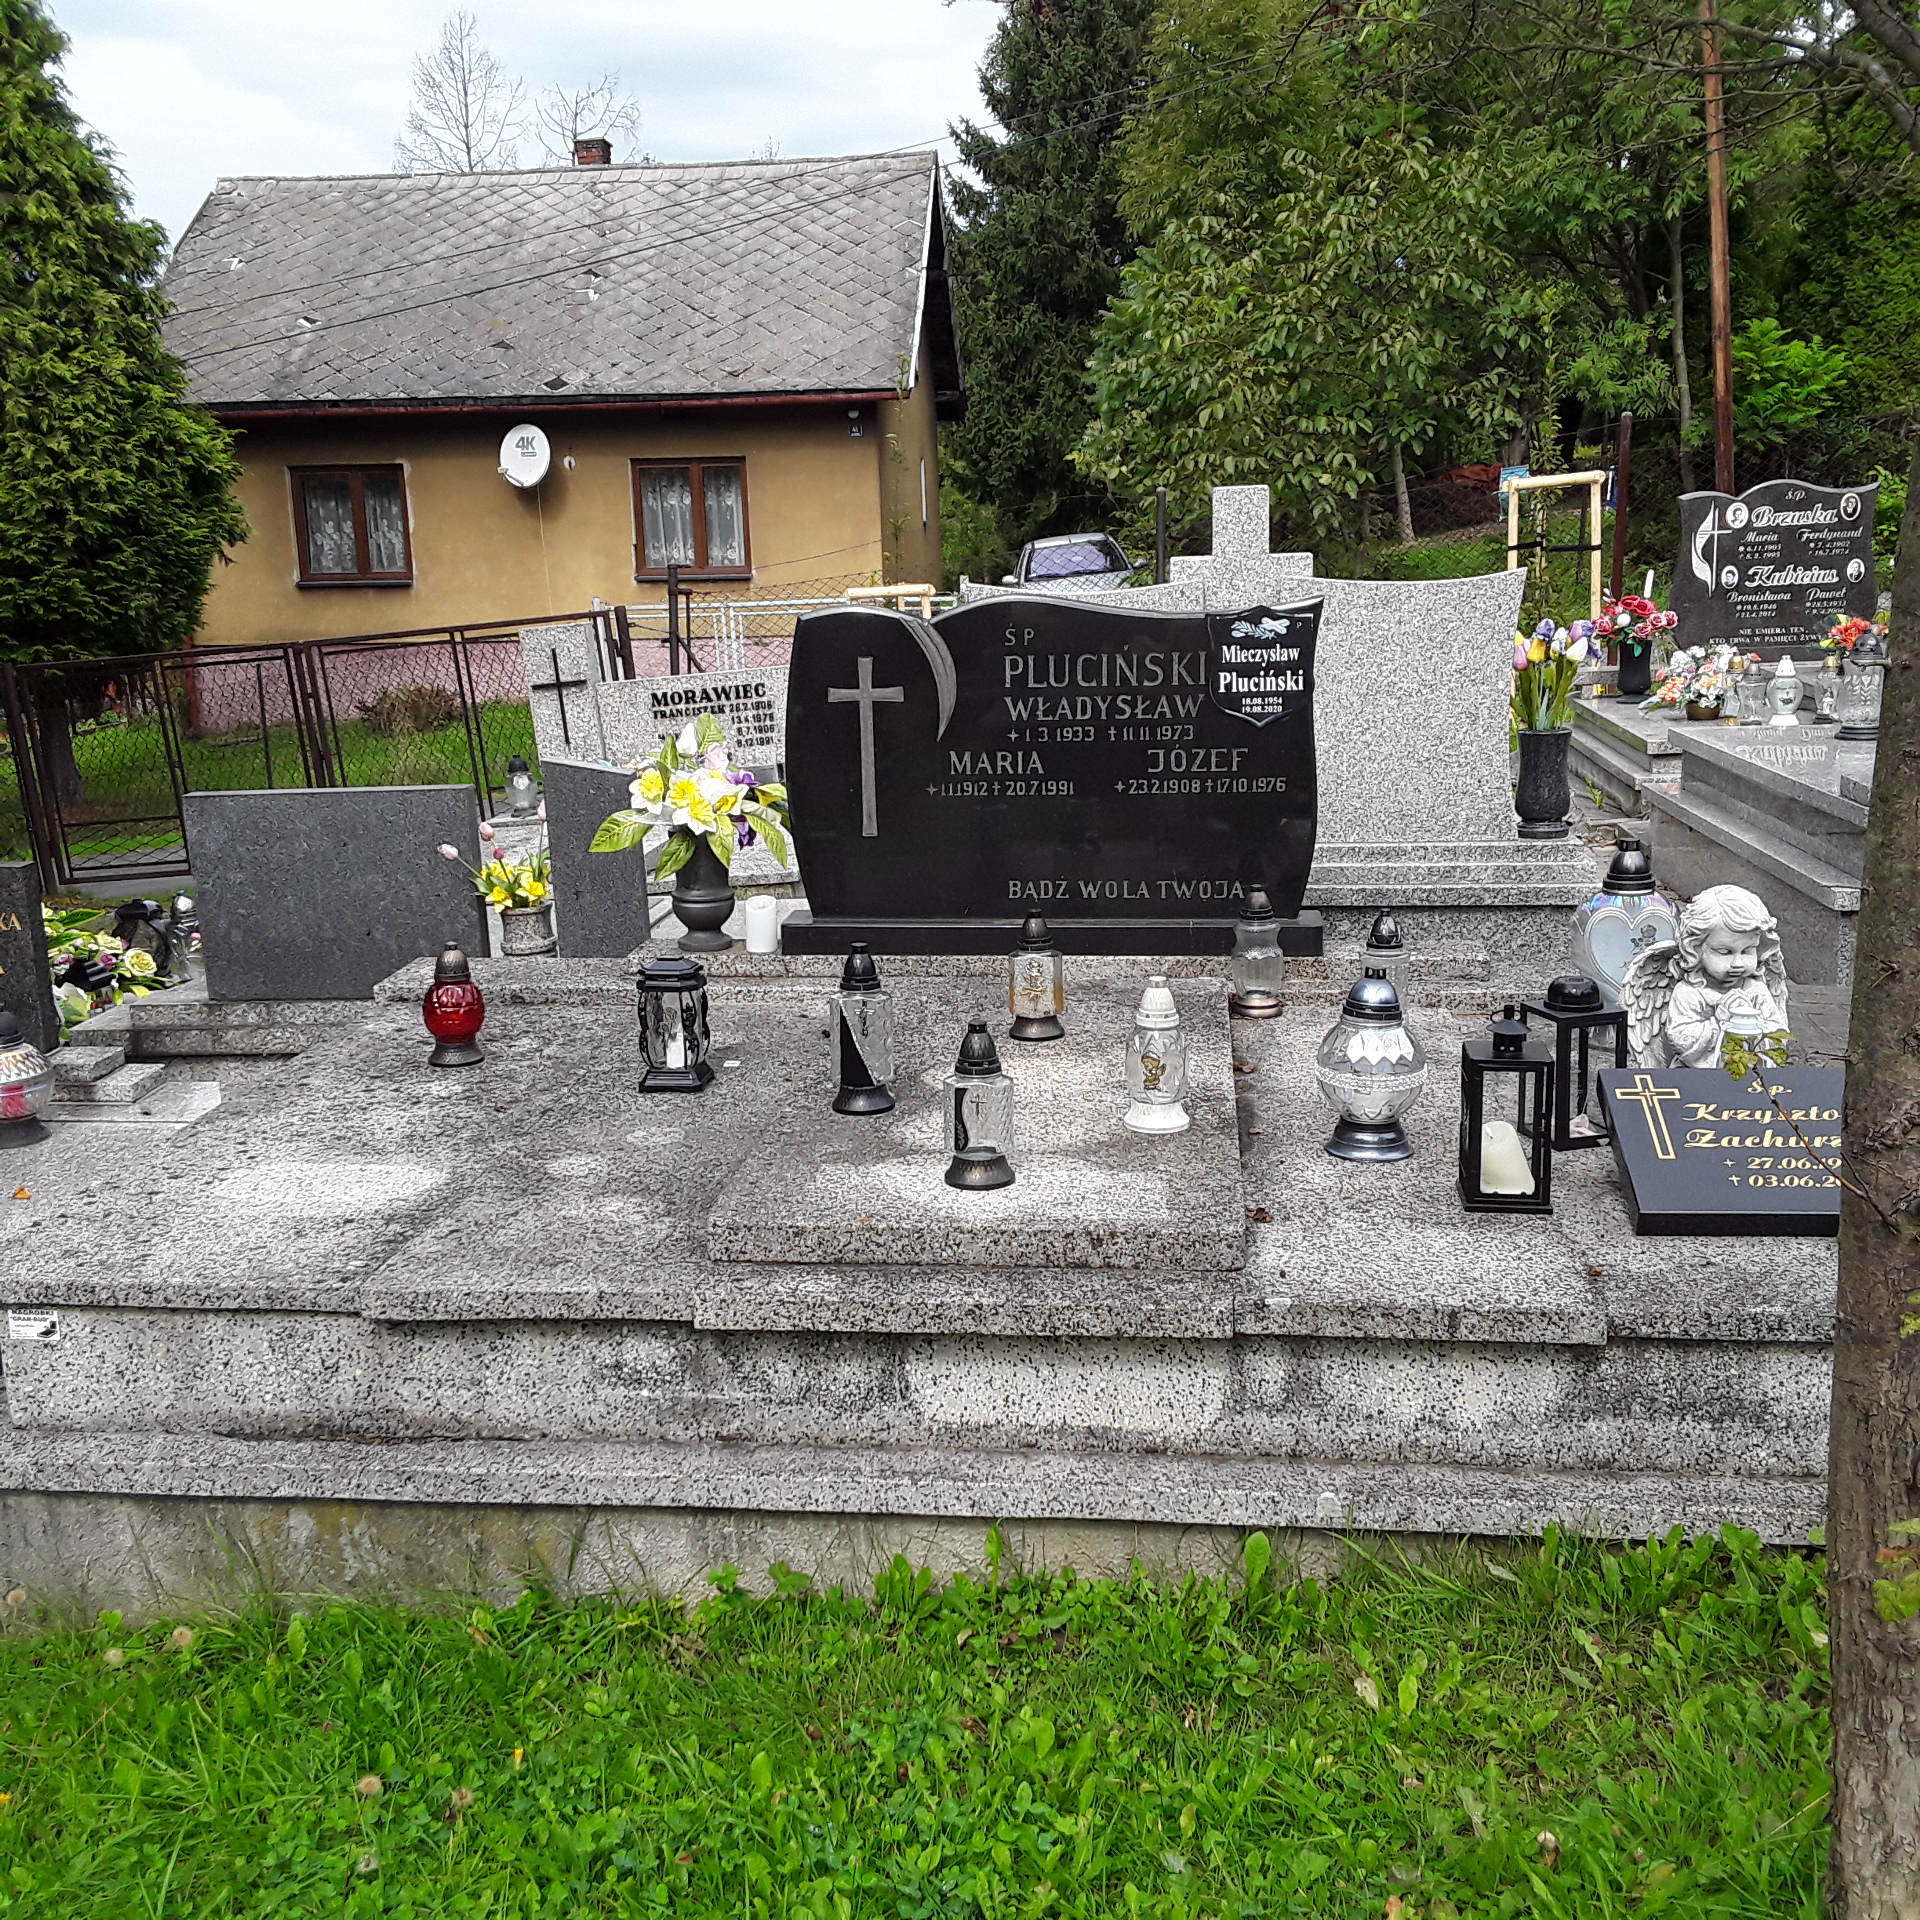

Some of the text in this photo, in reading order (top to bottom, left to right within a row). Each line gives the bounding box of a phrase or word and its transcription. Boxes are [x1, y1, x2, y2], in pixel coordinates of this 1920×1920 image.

[515, 436, 536, 450] 4K
[1751, 503, 1839, 527] Brzuska
[1740, 531, 1780, 542] Maria
[1796, 526, 1863, 542] Ferdynand
[1744, 564, 1839, 587] Kubicius
[1727, 590, 1791, 602] Bronisława
[1806, 587, 1847, 601] Paweł
[1729, 636, 1751, 644] TRWA
[1756, 627, 1786, 635] UMIERA
[1221, 644, 1300, 667] Mieczysław
[1004, 644, 1207, 688] PLUCIŃSKI
[1218, 670, 1304, 693] Pluciński
[650, 683, 766, 708] MORAWIEC
[1242, 696, 1282, 705] 18.08.1954
[653, 703, 726, 720] FRANCISZEK
[1004, 694, 1206, 721] WŁADYSŁAW
[1242, 705, 1282, 713] 19.08.2020
[949, 750, 1045, 775] MARIA
[1146, 744, 1249, 773] JÓZEF
[1078, 880, 1151, 899] WOLA
[1156, 880, 1246, 900] TWOJA
